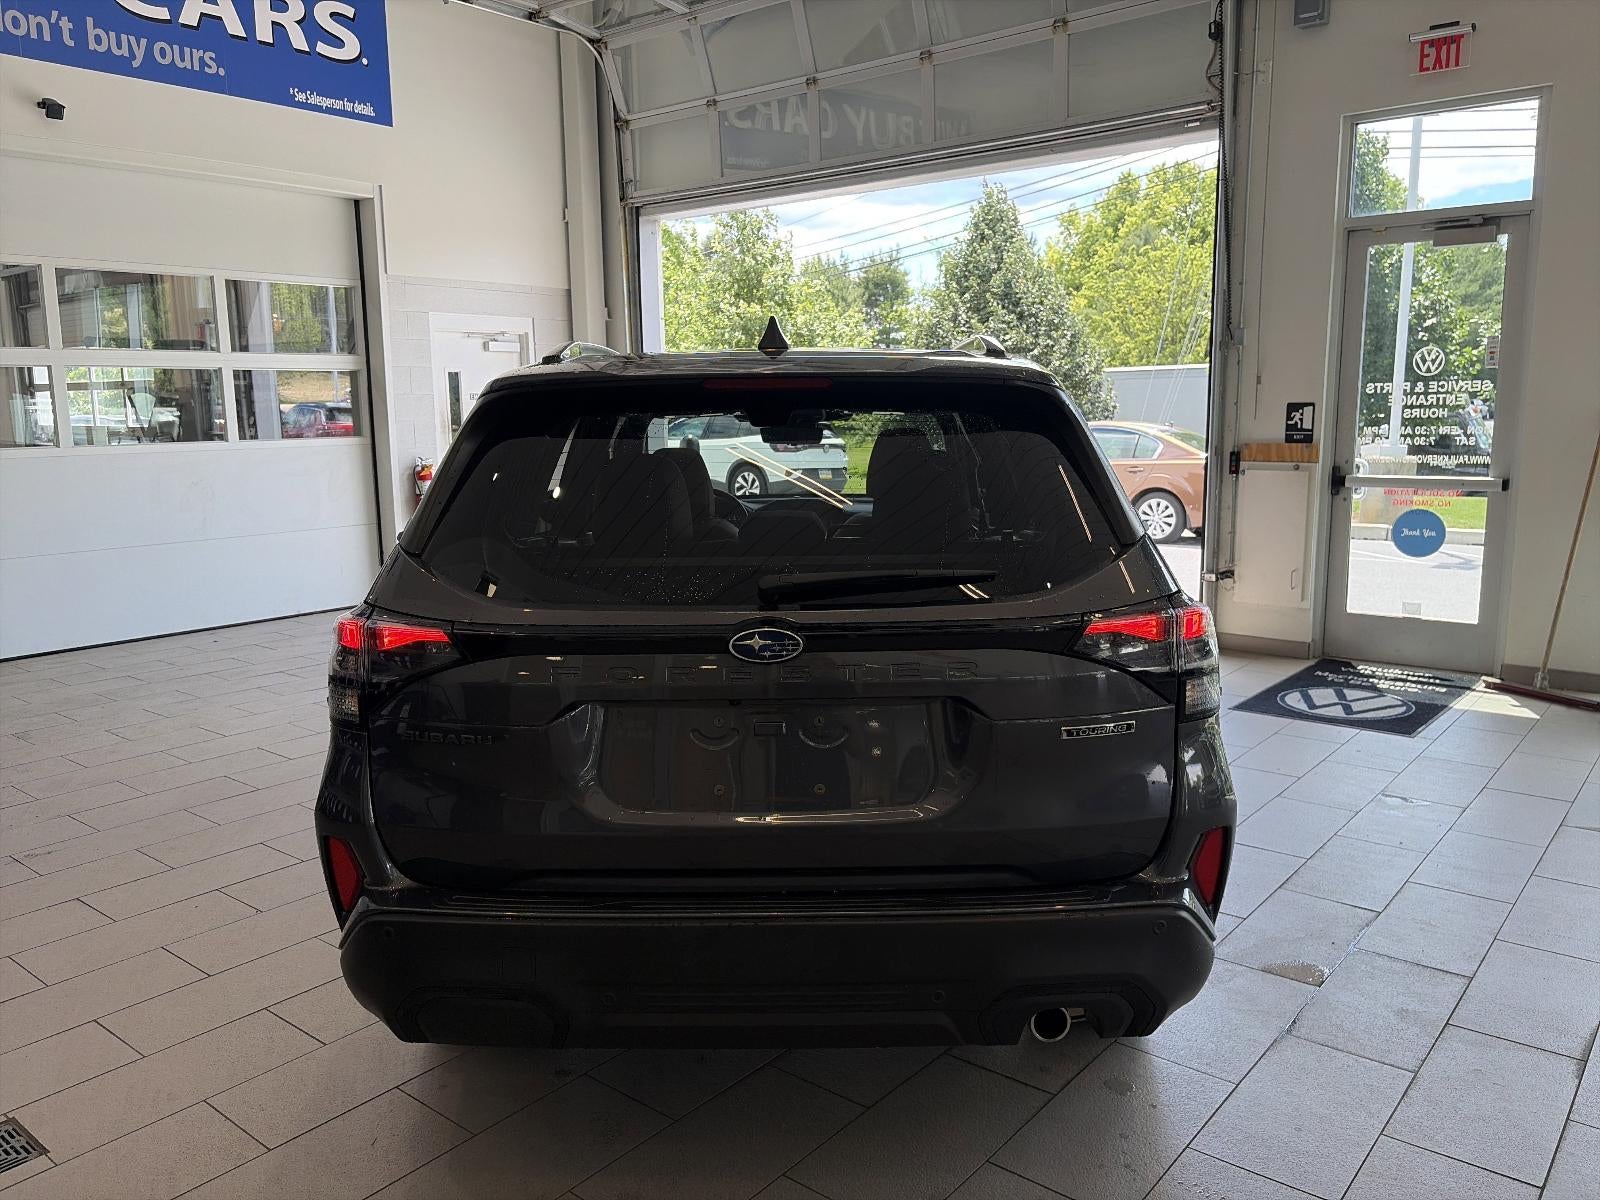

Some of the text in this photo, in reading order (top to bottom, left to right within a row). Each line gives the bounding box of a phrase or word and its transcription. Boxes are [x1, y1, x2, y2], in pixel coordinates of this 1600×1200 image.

[0, 3, 225, 76] on't buy ours.
[1418, 33, 1465, 73] EXIT
[294, 88, 306, 102] See
[306, 90, 344, 110] Salesperson
[344, 97, 353, 112] for
[354, 100, 376, 117] details.
[1400, 527, 1436, 539] Thank You
[550, 661, 979, 684] FORESTER
[400, 729, 496, 745] SUBARU
[1071, 723, 1128, 737] TOURING
